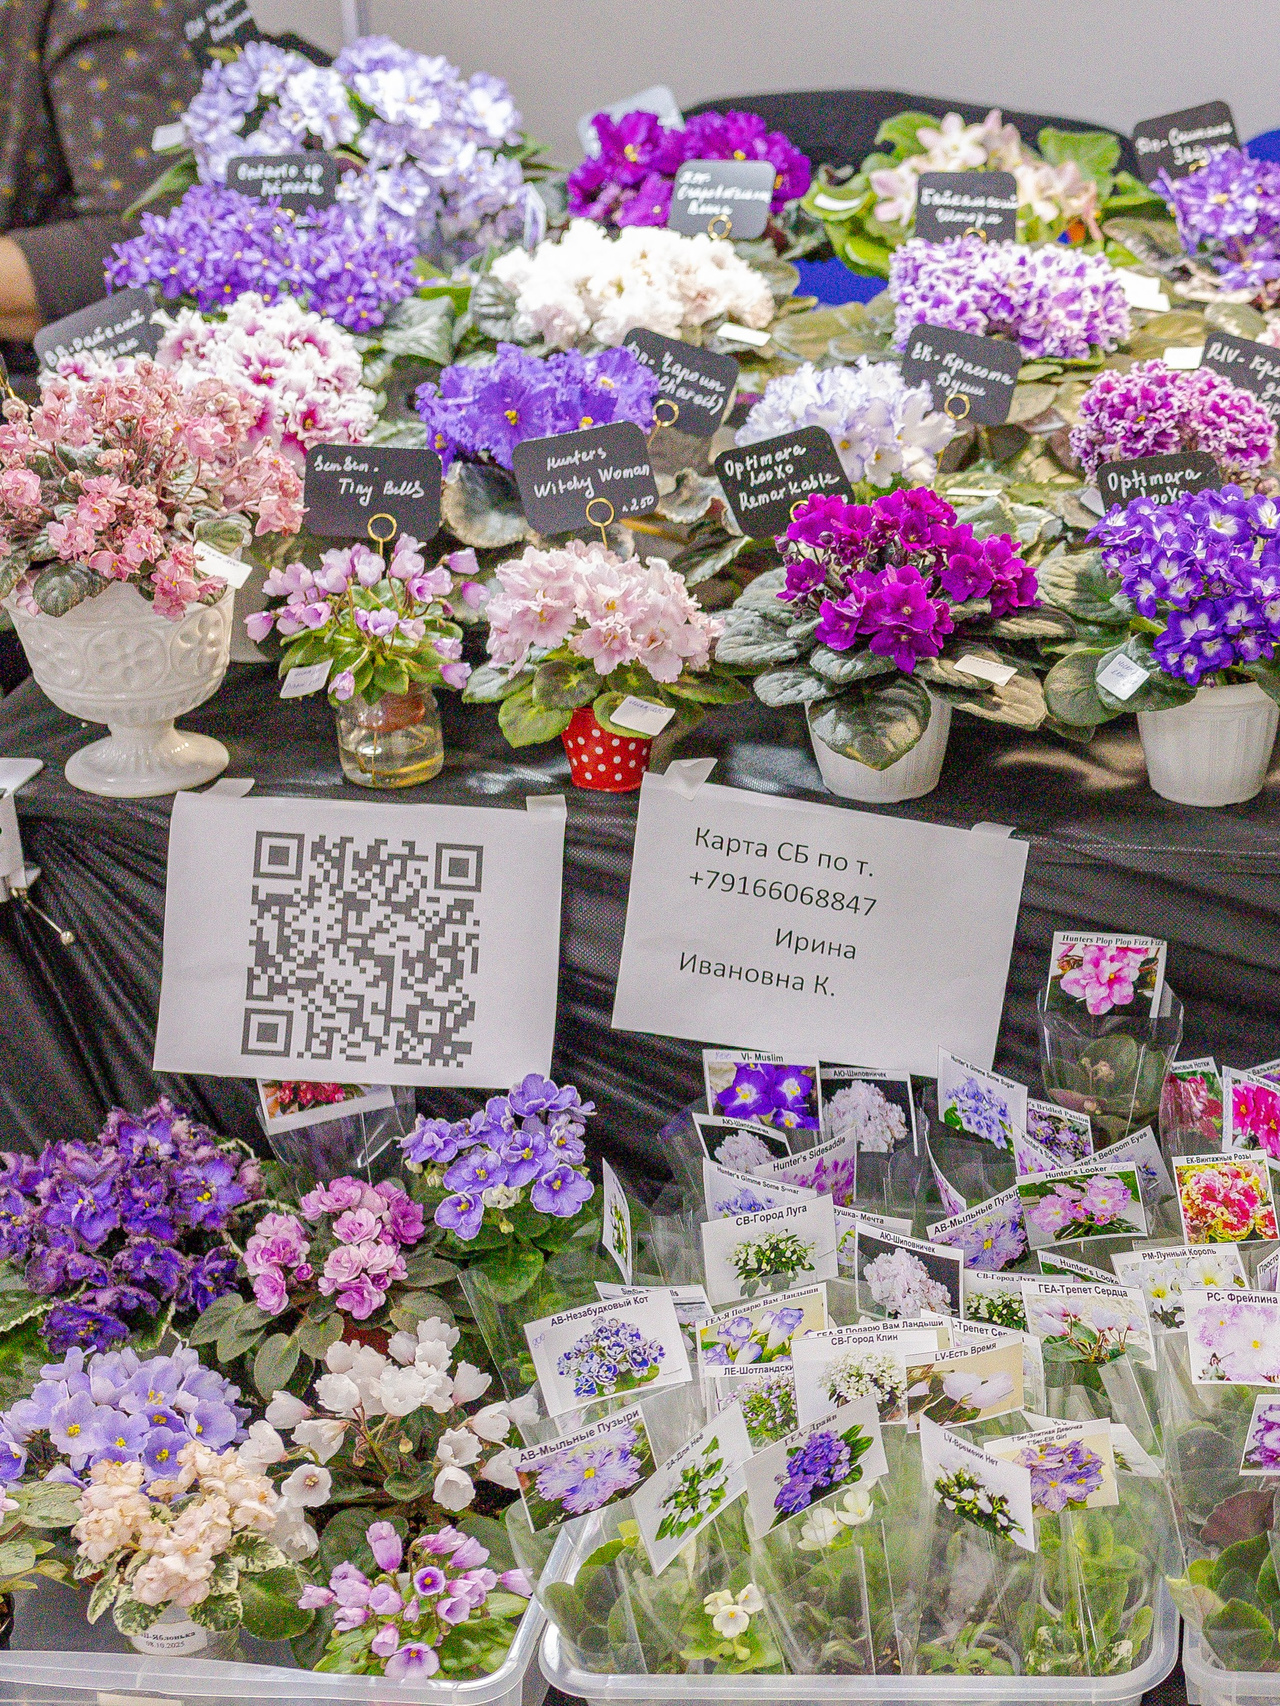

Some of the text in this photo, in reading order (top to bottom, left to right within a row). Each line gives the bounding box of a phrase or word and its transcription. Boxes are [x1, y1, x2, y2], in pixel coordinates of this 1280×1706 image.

[546, 448, 607, 472] Hunters
[723, 444, 808, 477] Optimara
[533, 464, 650, 499] Witchy Woman
[739, 472, 840, 512] Remarkable
[1106, 467, 1202, 498] Optimara
[695, 827, 873, 877] Карта СБ по т.
[690, 869, 877, 916] +79166068847
[775, 928, 857, 960] Ирина
[1062, 934, 1165, 949] Hunters Plop Plop Fizz Fizz
[680, 952, 835, 997] Ивановна К.
[755, 1054, 784, 1062] Muslim
[772, 1137, 846, 1172] Hunter's Sidesaddle
[1233, 1153, 1252, 1161] Розы
[735, 1205, 808, 1227] СВ-Город Луга
[879, 1230, 936, 1254] АЮ-Шиповничек
[1141, 1248, 1217, 1261] РМ-Лунный Король
[762, 1297, 779, 1308] Вам
[779, 1287, 819, 1302] Ландыши
[1037, 1283, 1129, 1299] ГЕА-Трепет Сердца
[1227, 1293, 1279, 1305] Фрейлина
[550, 1294, 649, 1327] АВ-Незабудковый Кот
[901, 1319, 944, 1330] Ландыши
[831, 1332, 899, 1346] СВ-Город Клин
[934, 1341, 997, 1362] LV-Есть Время
[519, 1408, 641, 1463] АВ-Мыльные Пузыри
[985, 1455, 999, 1467] Нет
